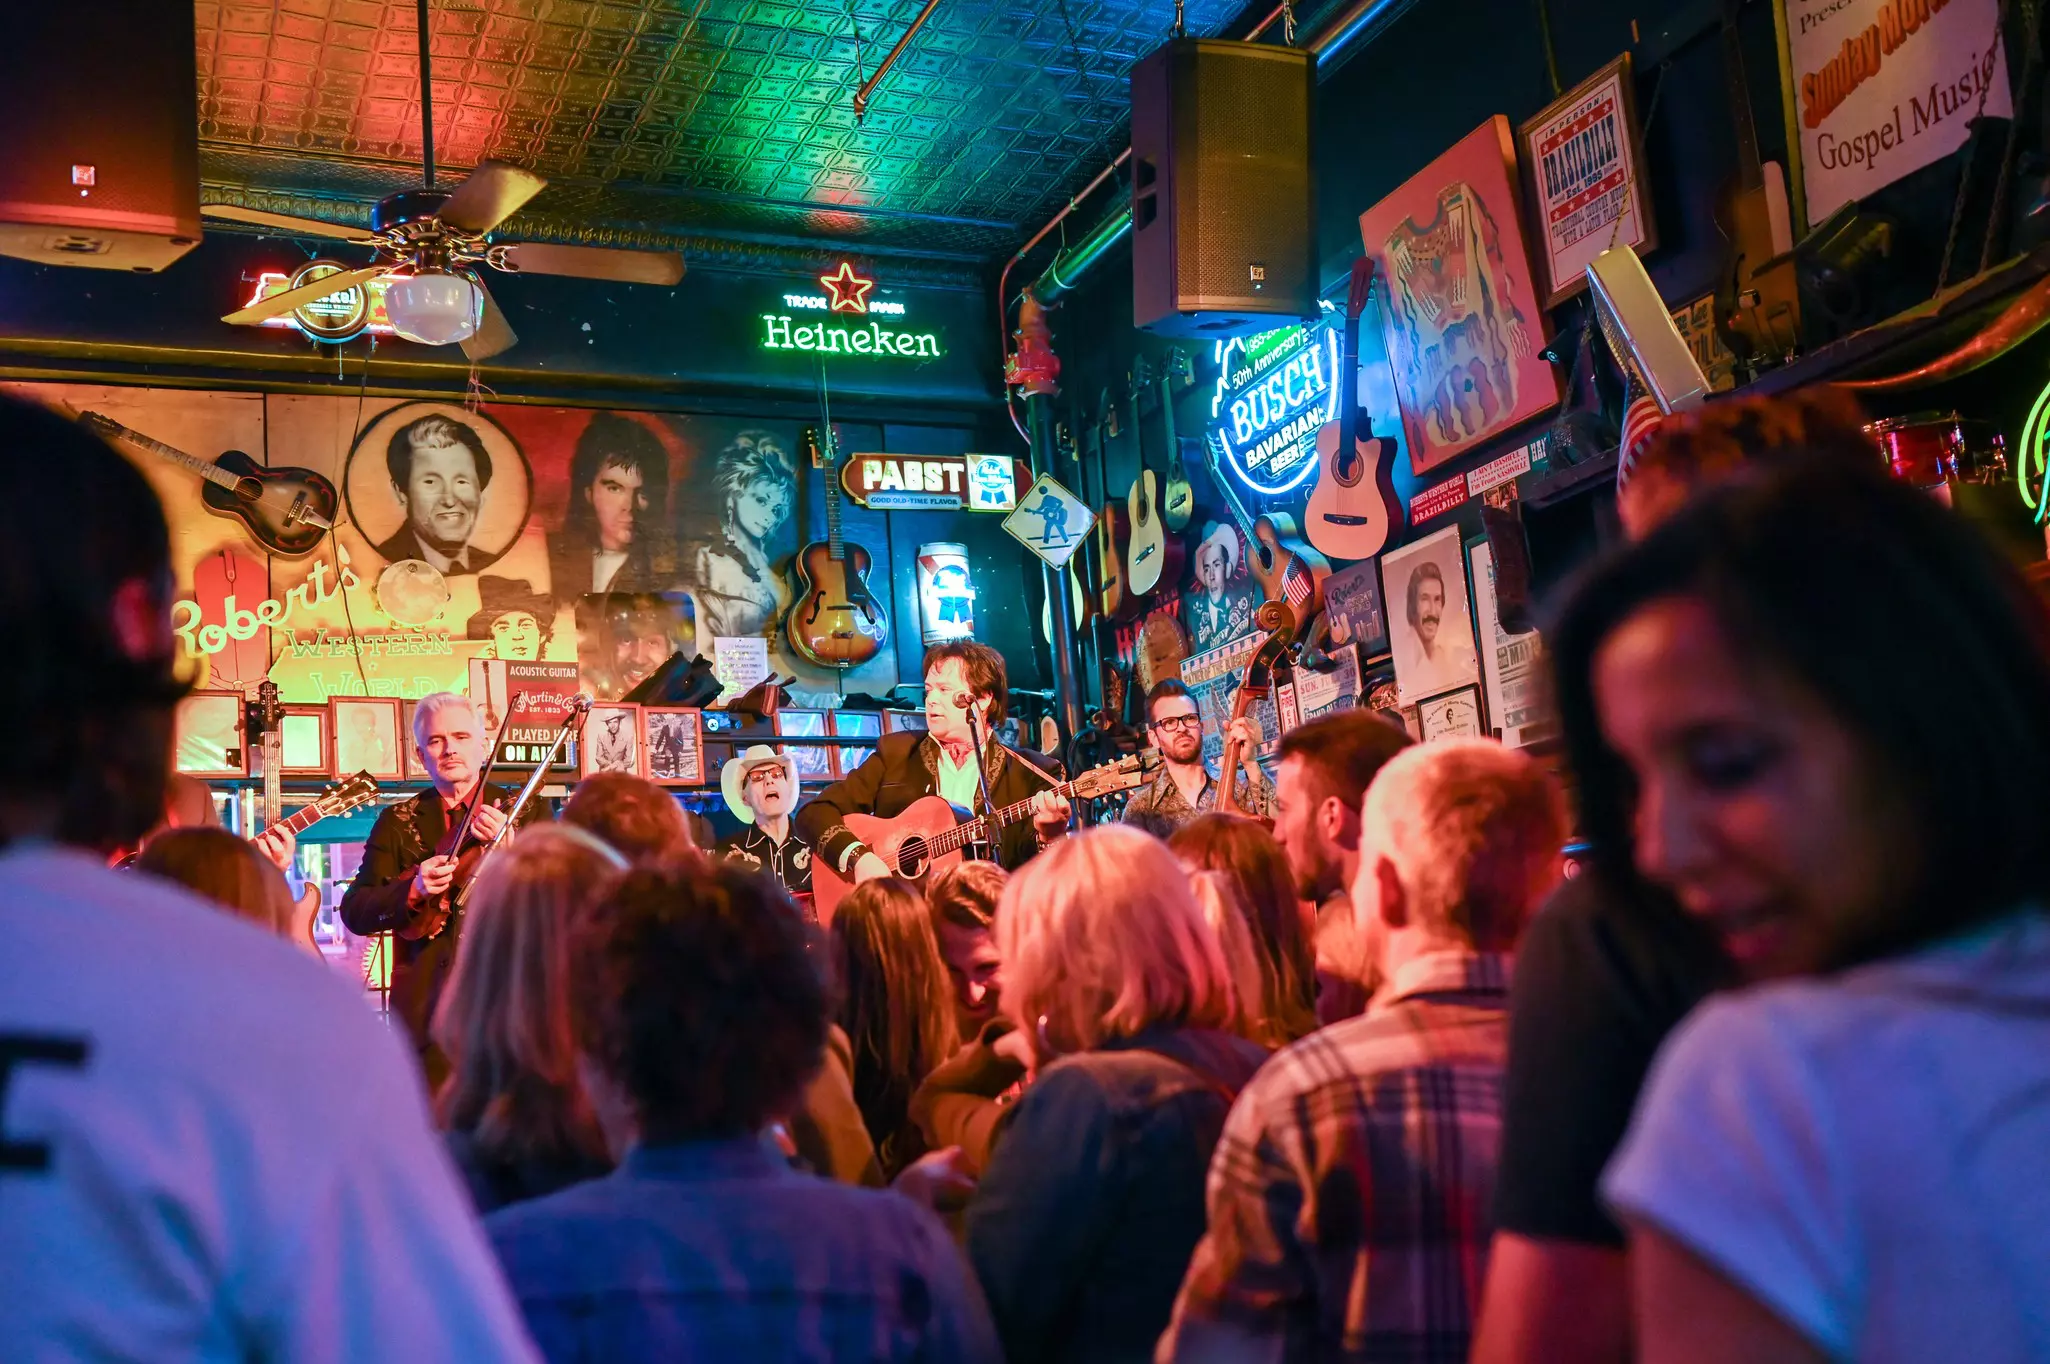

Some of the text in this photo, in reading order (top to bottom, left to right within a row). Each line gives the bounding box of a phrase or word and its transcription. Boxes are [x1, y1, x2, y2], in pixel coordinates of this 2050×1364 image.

[1800, 0, 1851, 35] Prese
[1801, 23, 1881, 129] Sunday
[1560, 94, 1605, 130] PERSON!
[1817, 46, 1996, 170] Gospel Music
[1543, 114, 1618, 200] BRASILBILLY
[1566, 184, 1583, 199] Est.
[783, 294, 906, 315] TRADE MARK
[763, 315, 941, 356] Heineken
[1232, 329, 1301, 390] 50th Anniversary
[1230, 343, 1327, 446] BUSCH
[1245, 408, 1323, 469] BAVARIAN
[1270, 443, 1305, 474] BEER
[863, 460, 965, 492] PABST
[870, 496, 891, 504] GOOD
[1414, 493, 1464, 525] BRAZILBILLY
[170, 544, 361, 659] Robert's
[285, 629, 452, 658] WESTERN
[310, 671, 440, 698] WORLD
[510, 666, 576, 678] ACOUSTIC GUITAR
[1300, 682, 1318, 695] SUN.
[1343, 667, 1356, 680] 30
[512, 728, 579, 741] PLAYED HRE
[505, 744, 526, 762] ON
